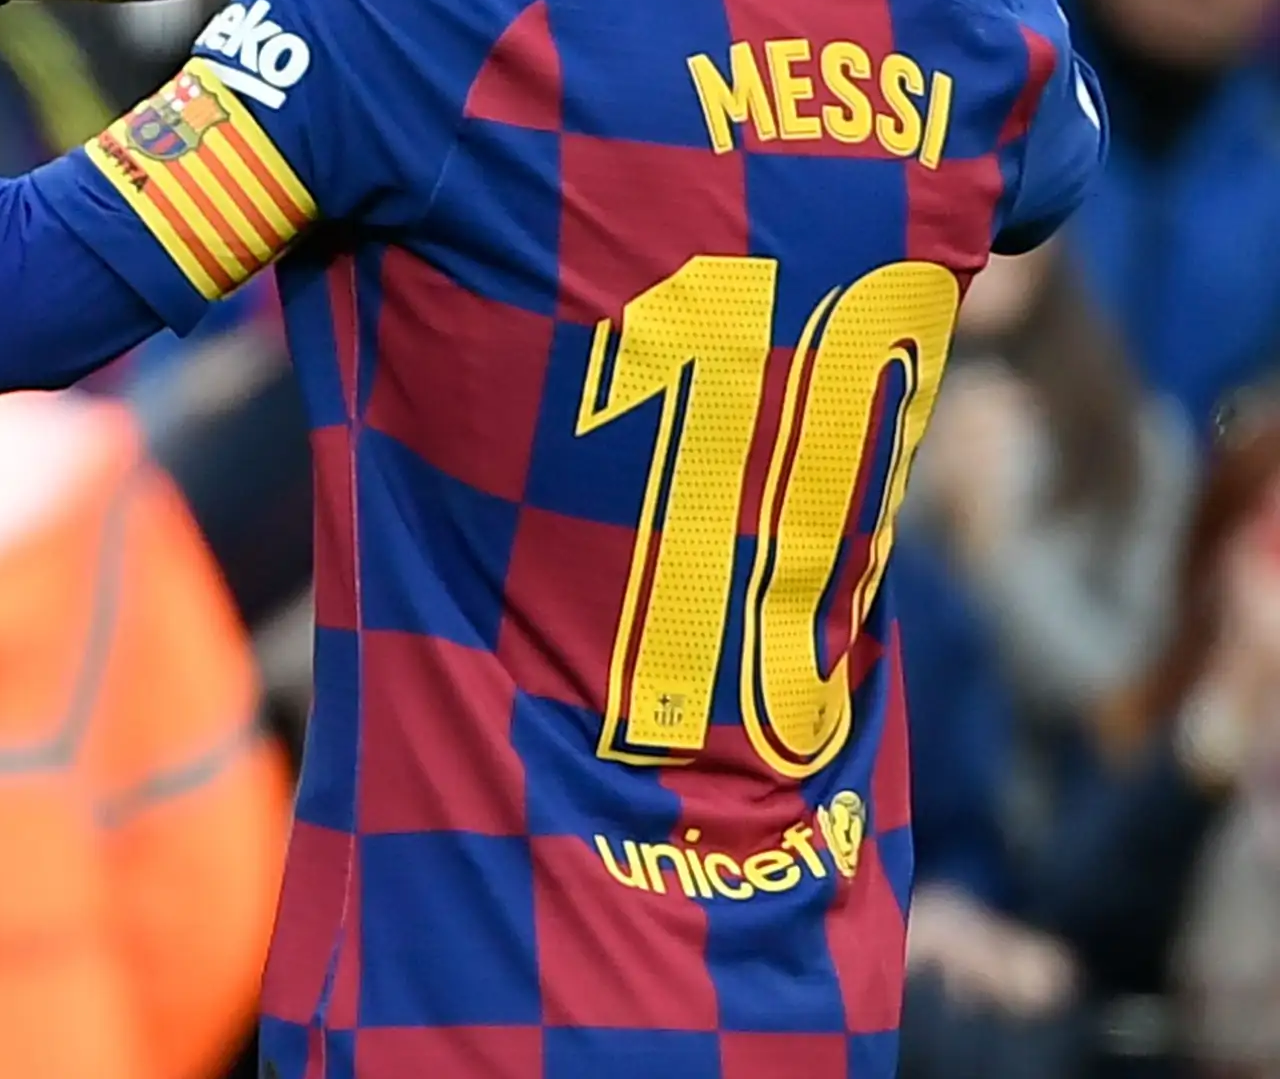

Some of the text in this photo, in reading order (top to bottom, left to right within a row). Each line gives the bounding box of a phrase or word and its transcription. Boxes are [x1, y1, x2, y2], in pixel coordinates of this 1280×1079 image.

[686, 38, 953, 171] MESSI
[574, 255, 961, 779] 10
[593, 820, 827, 900] unicef
